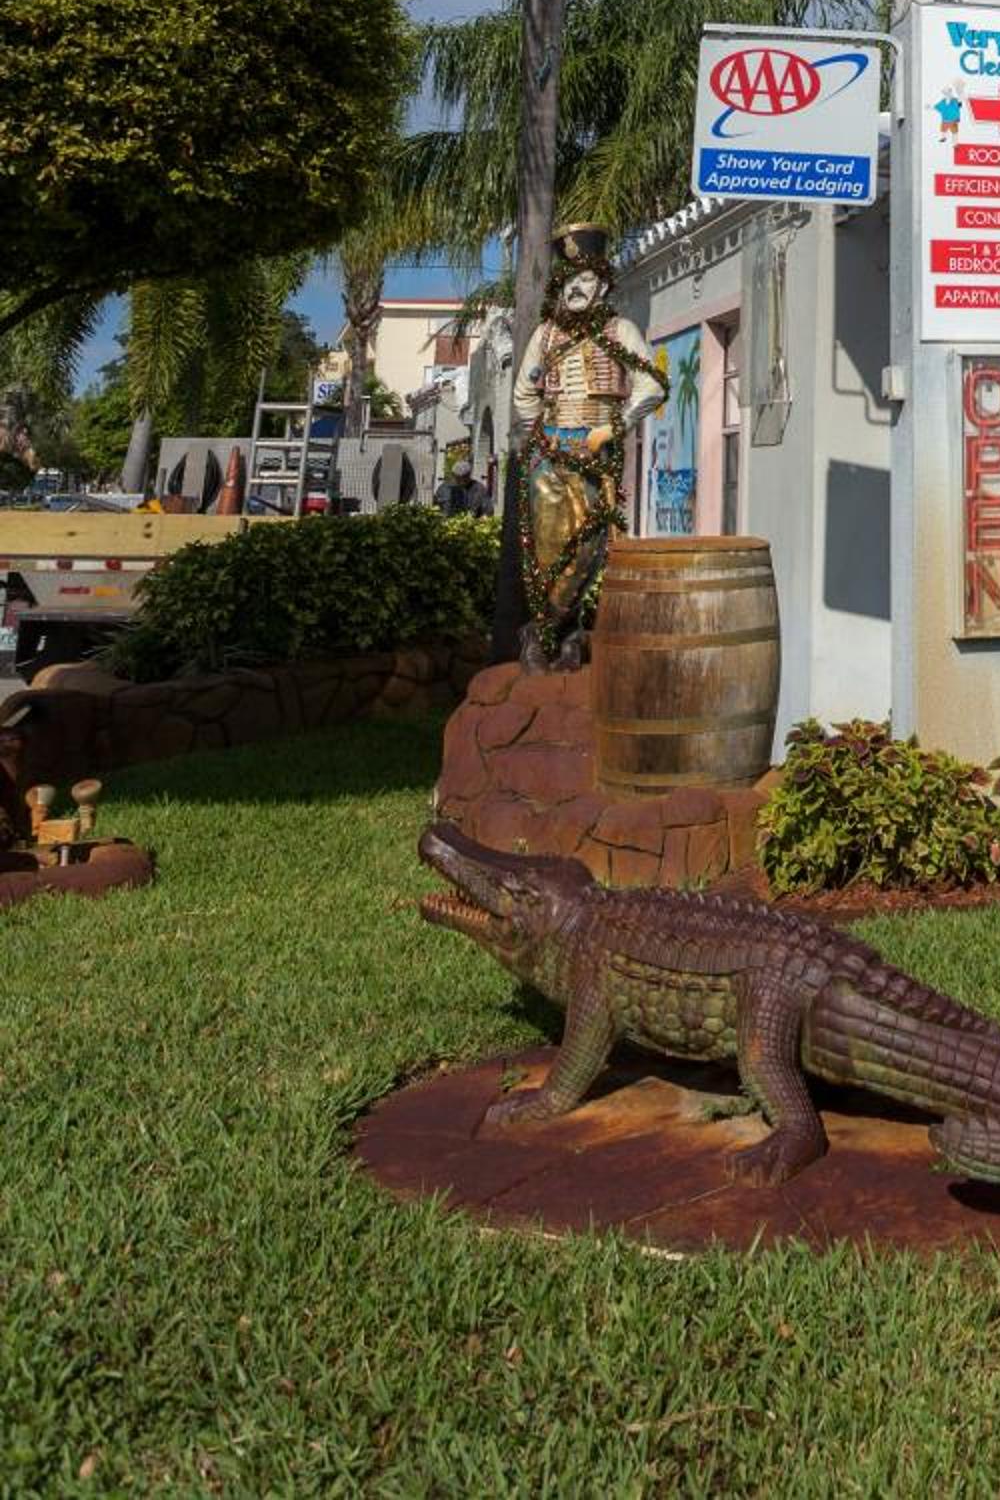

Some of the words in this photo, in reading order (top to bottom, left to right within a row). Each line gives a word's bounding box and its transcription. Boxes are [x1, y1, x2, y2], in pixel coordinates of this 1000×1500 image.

[722, 51, 809, 114] AAA
[715, 154, 767, 170] Show
[771, 158, 811, 174] Your
[814, 160, 855, 175] Card
[705, 172, 791, 190] Approved
[795, 176, 865, 198] Lodging
